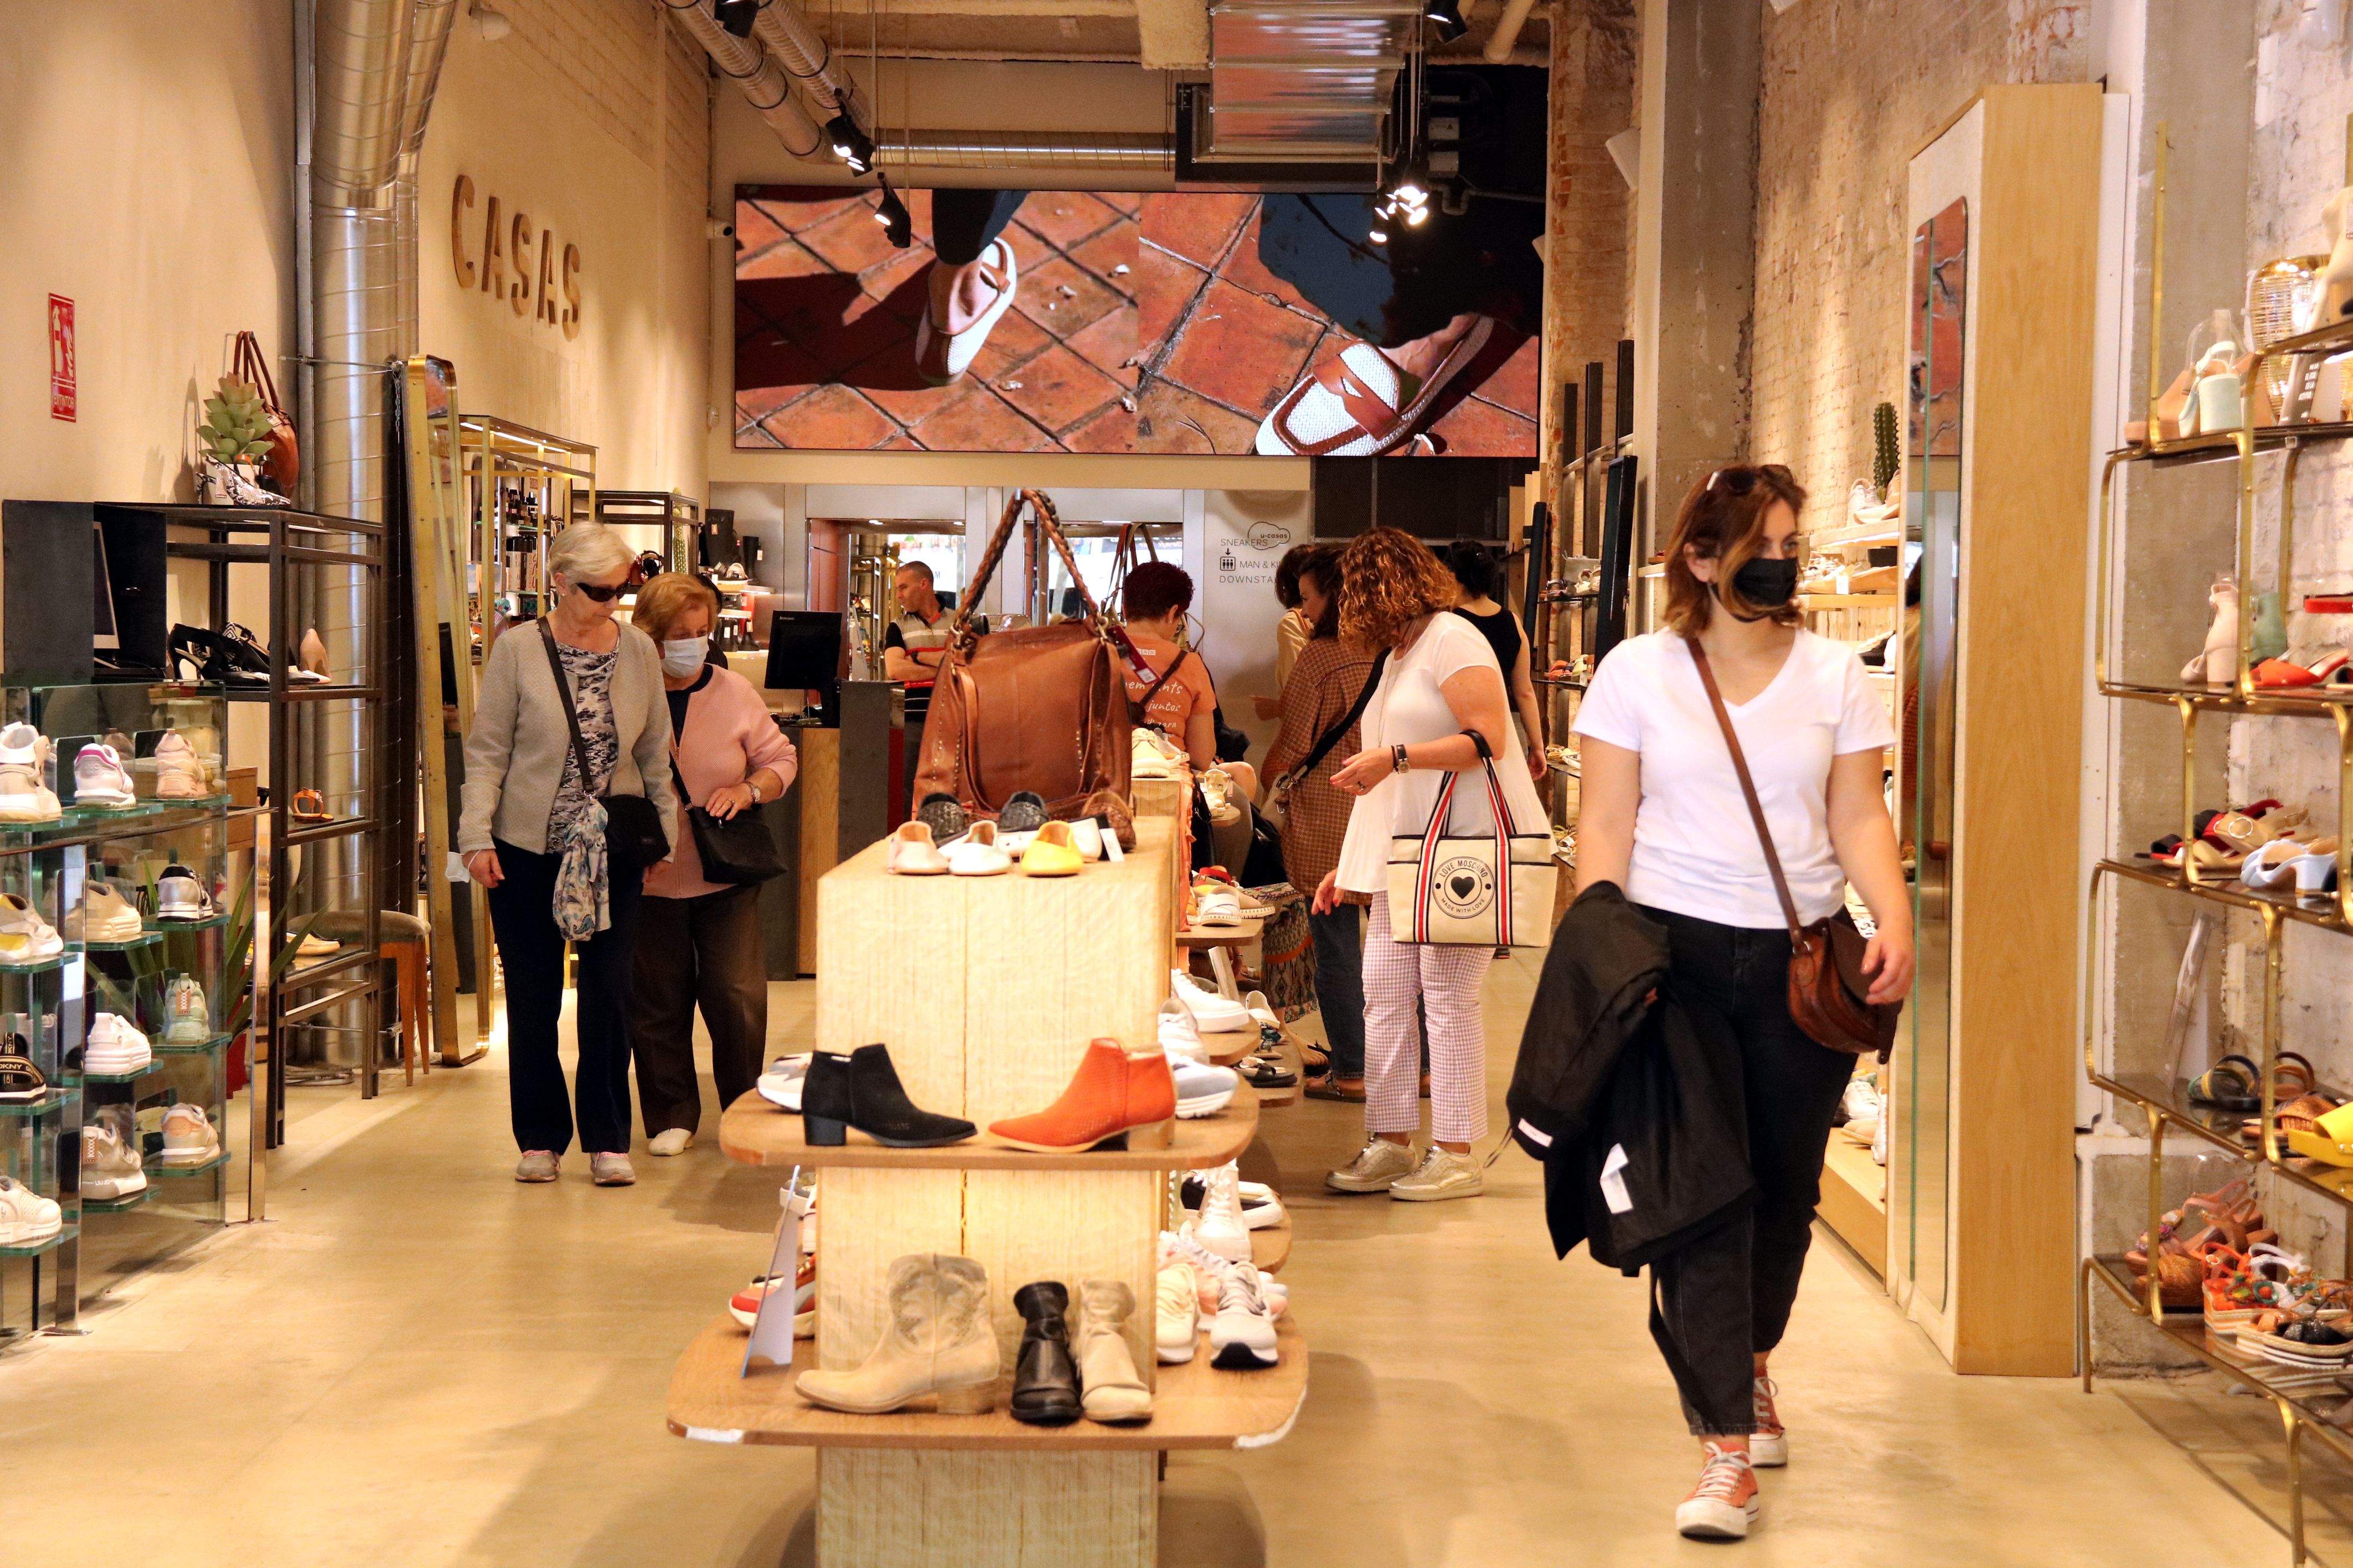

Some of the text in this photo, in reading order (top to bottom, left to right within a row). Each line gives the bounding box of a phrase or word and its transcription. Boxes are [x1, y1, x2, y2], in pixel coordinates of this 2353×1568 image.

[451, 174, 581, 341] CASAS
[1147, 700, 1181, 712] juntos
[1439, 860, 1488, 877] LOVE MOSCHINO
[1441, 898, 1454, 910] MADE
[1472, 898, 1485, 910] LOVE
